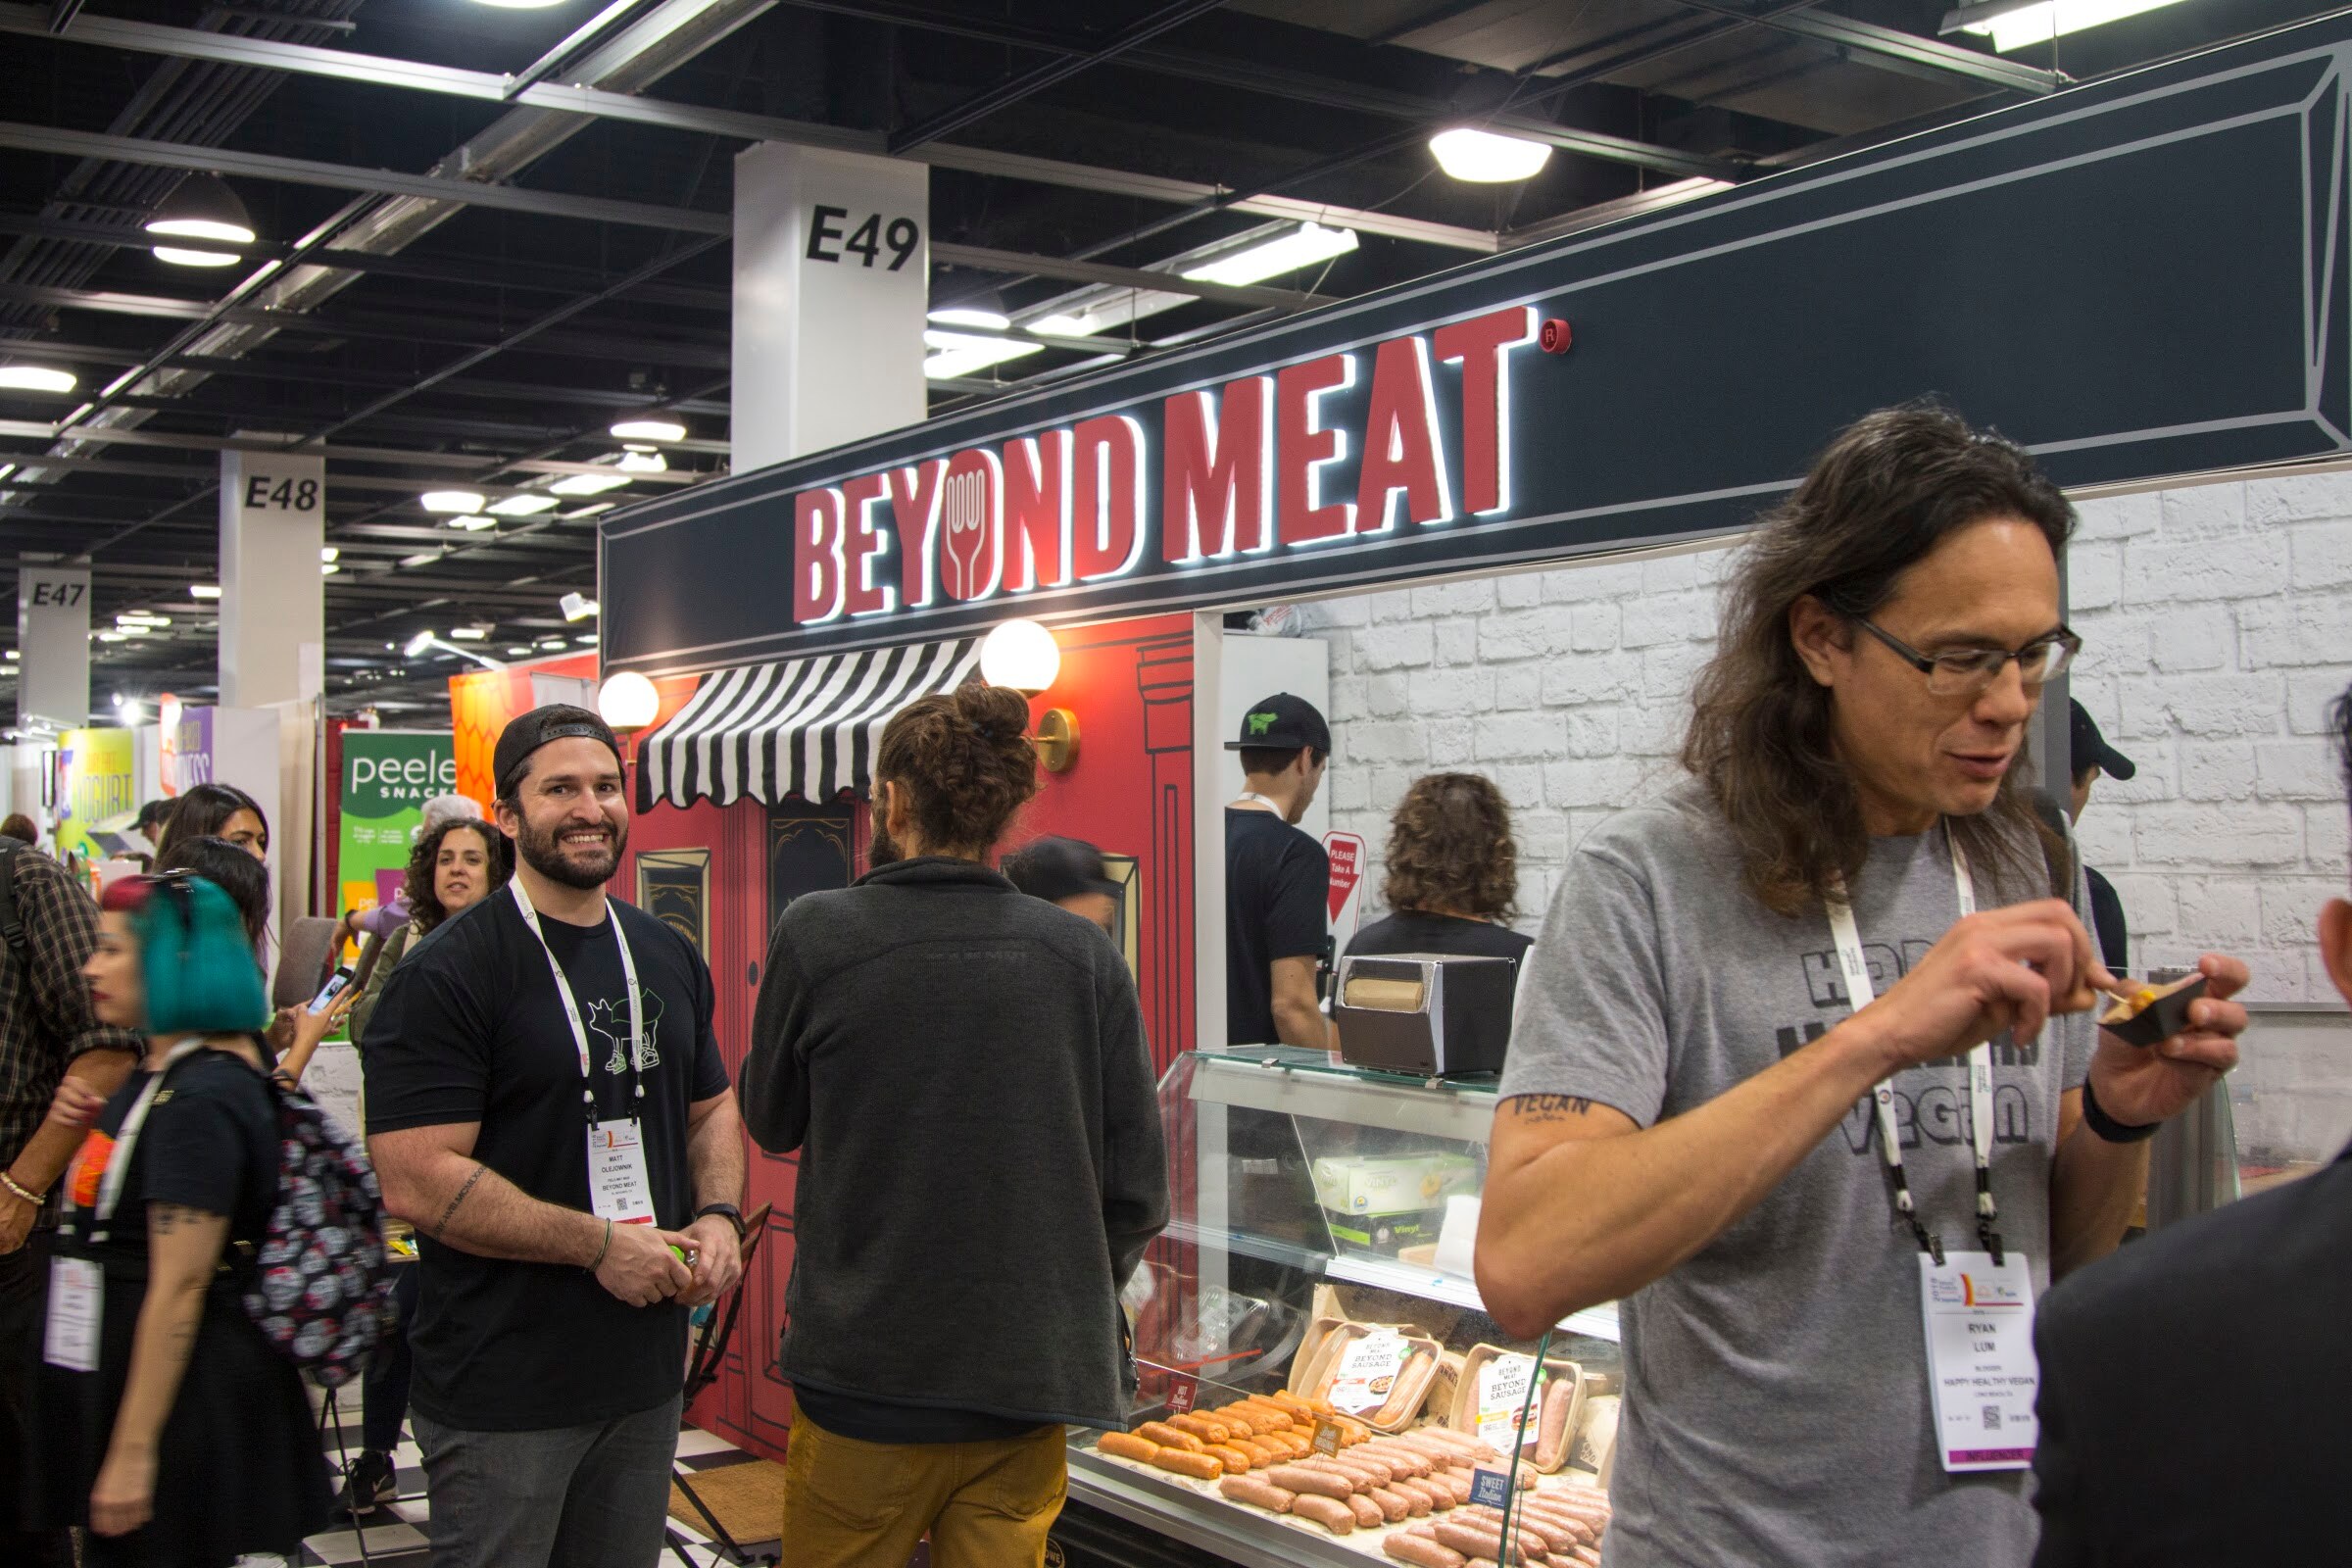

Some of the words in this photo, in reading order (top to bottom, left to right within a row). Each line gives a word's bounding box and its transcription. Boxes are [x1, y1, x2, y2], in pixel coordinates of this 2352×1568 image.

[807, 204, 919, 271] E49
[794, 413, 1146, 625] BEYOND
[1163, 306, 1537, 564] MEAT
[245, 475, 318, 511] E48
[33, 583, 86, 606] E47
[352, 750, 457, 794] peele
[1331, 850, 1355, 861] PLEASE
[601, 1163, 633, 1174] OLEJOWNIK
[603, 1183, 623, 1192] BEYOND
[1395, 1225, 1420, 1234] Vinyl
[1968, 1323, 1996, 1334] RYAN
[1974, 1342, 1995, 1352] LUM
[1354, 1353, 1393, 1362] BEYOND
[1351, 1360, 1392, 1369] SAUSAGE
[1498, 1365, 1521, 1376] BEYOND
[1492, 1378, 1527, 1392] BEYOND
[1972, 1378, 2007, 1387] HEALTHY
[2008, 1377, 2034, 1386] VEGAN
[1490, 1386, 1526, 1400] SAUSAGE
[1481, 1475, 1505, 1490] SWEET
[1478, 1486, 1502, 1501] Italian
